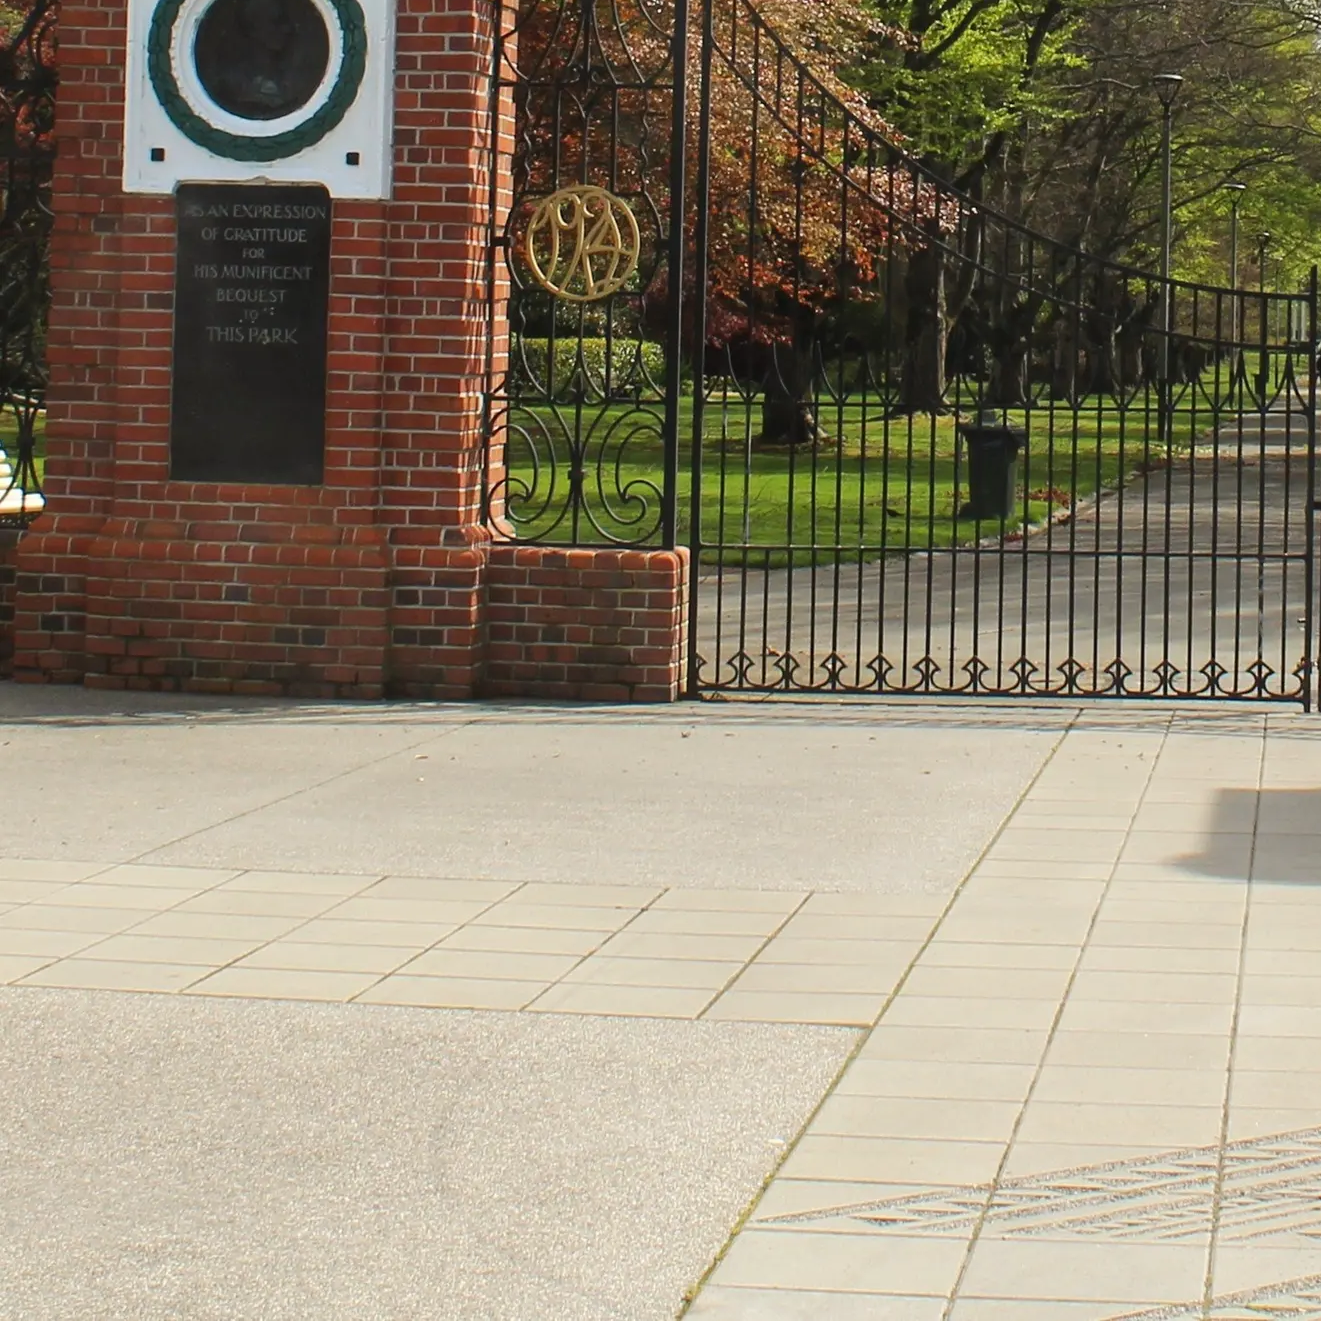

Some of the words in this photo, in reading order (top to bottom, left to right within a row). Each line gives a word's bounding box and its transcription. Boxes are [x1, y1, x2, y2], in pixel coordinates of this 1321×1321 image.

[206, 205, 229, 218] AN
[232, 204, 326, 219] EXPRESSION
[201, 228, 218, 241] OF
[224, 227, 307, 243] GRATITUDE
[242, 248, 265, 259] FOR
[193, 265, 218, 279] HIS
[221, 265, 313, 280] MUNIFICENT
[216, 288, 286, 303] BEQUEST
[206, 326, 244, 343] THIS
[248, 327, 298, 345] PARK
